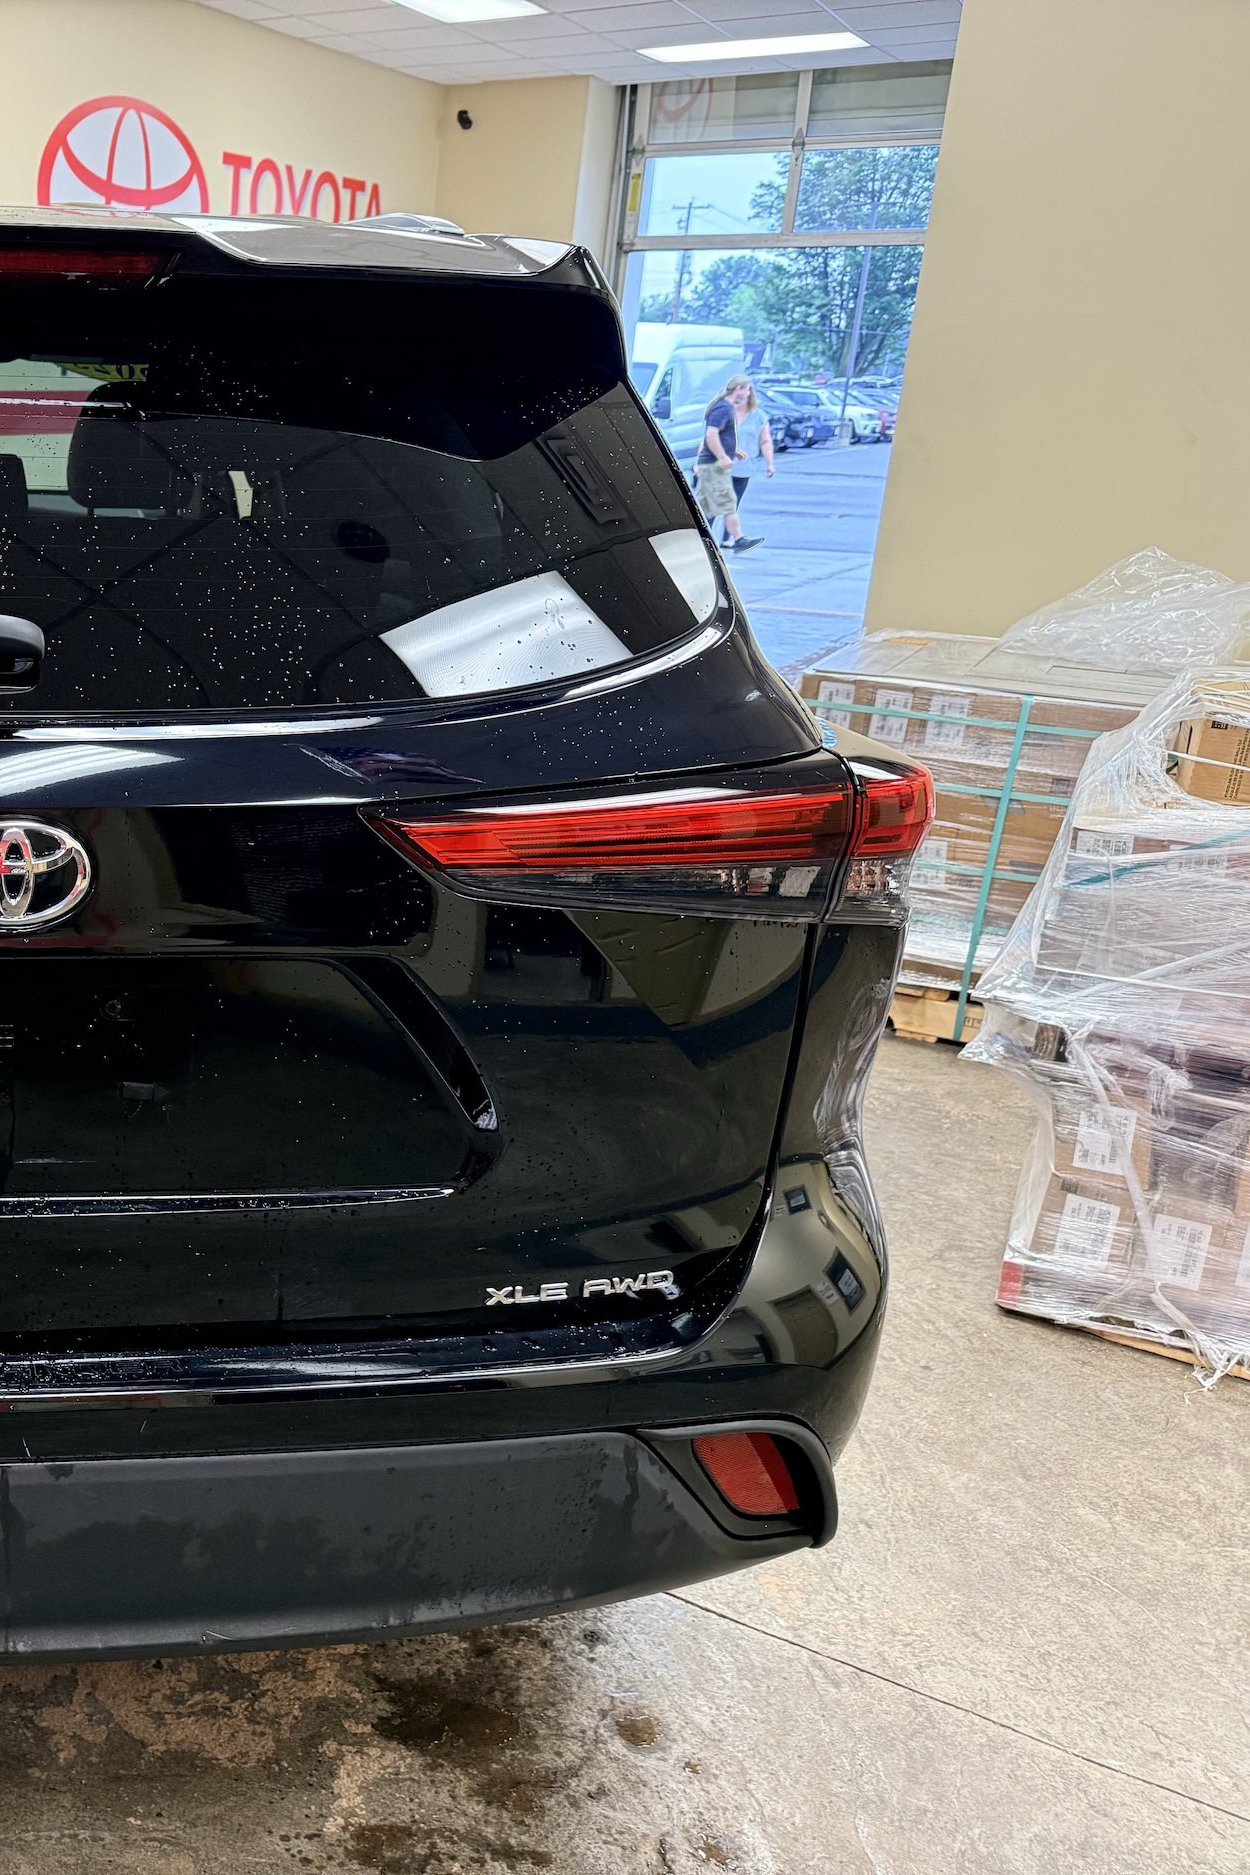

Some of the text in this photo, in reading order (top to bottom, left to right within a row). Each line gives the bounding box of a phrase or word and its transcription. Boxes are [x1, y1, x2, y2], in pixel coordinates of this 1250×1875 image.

[222, 151, 382, 224] TOYOTA
[484, 1270, 684, 1306] XLE AWD
